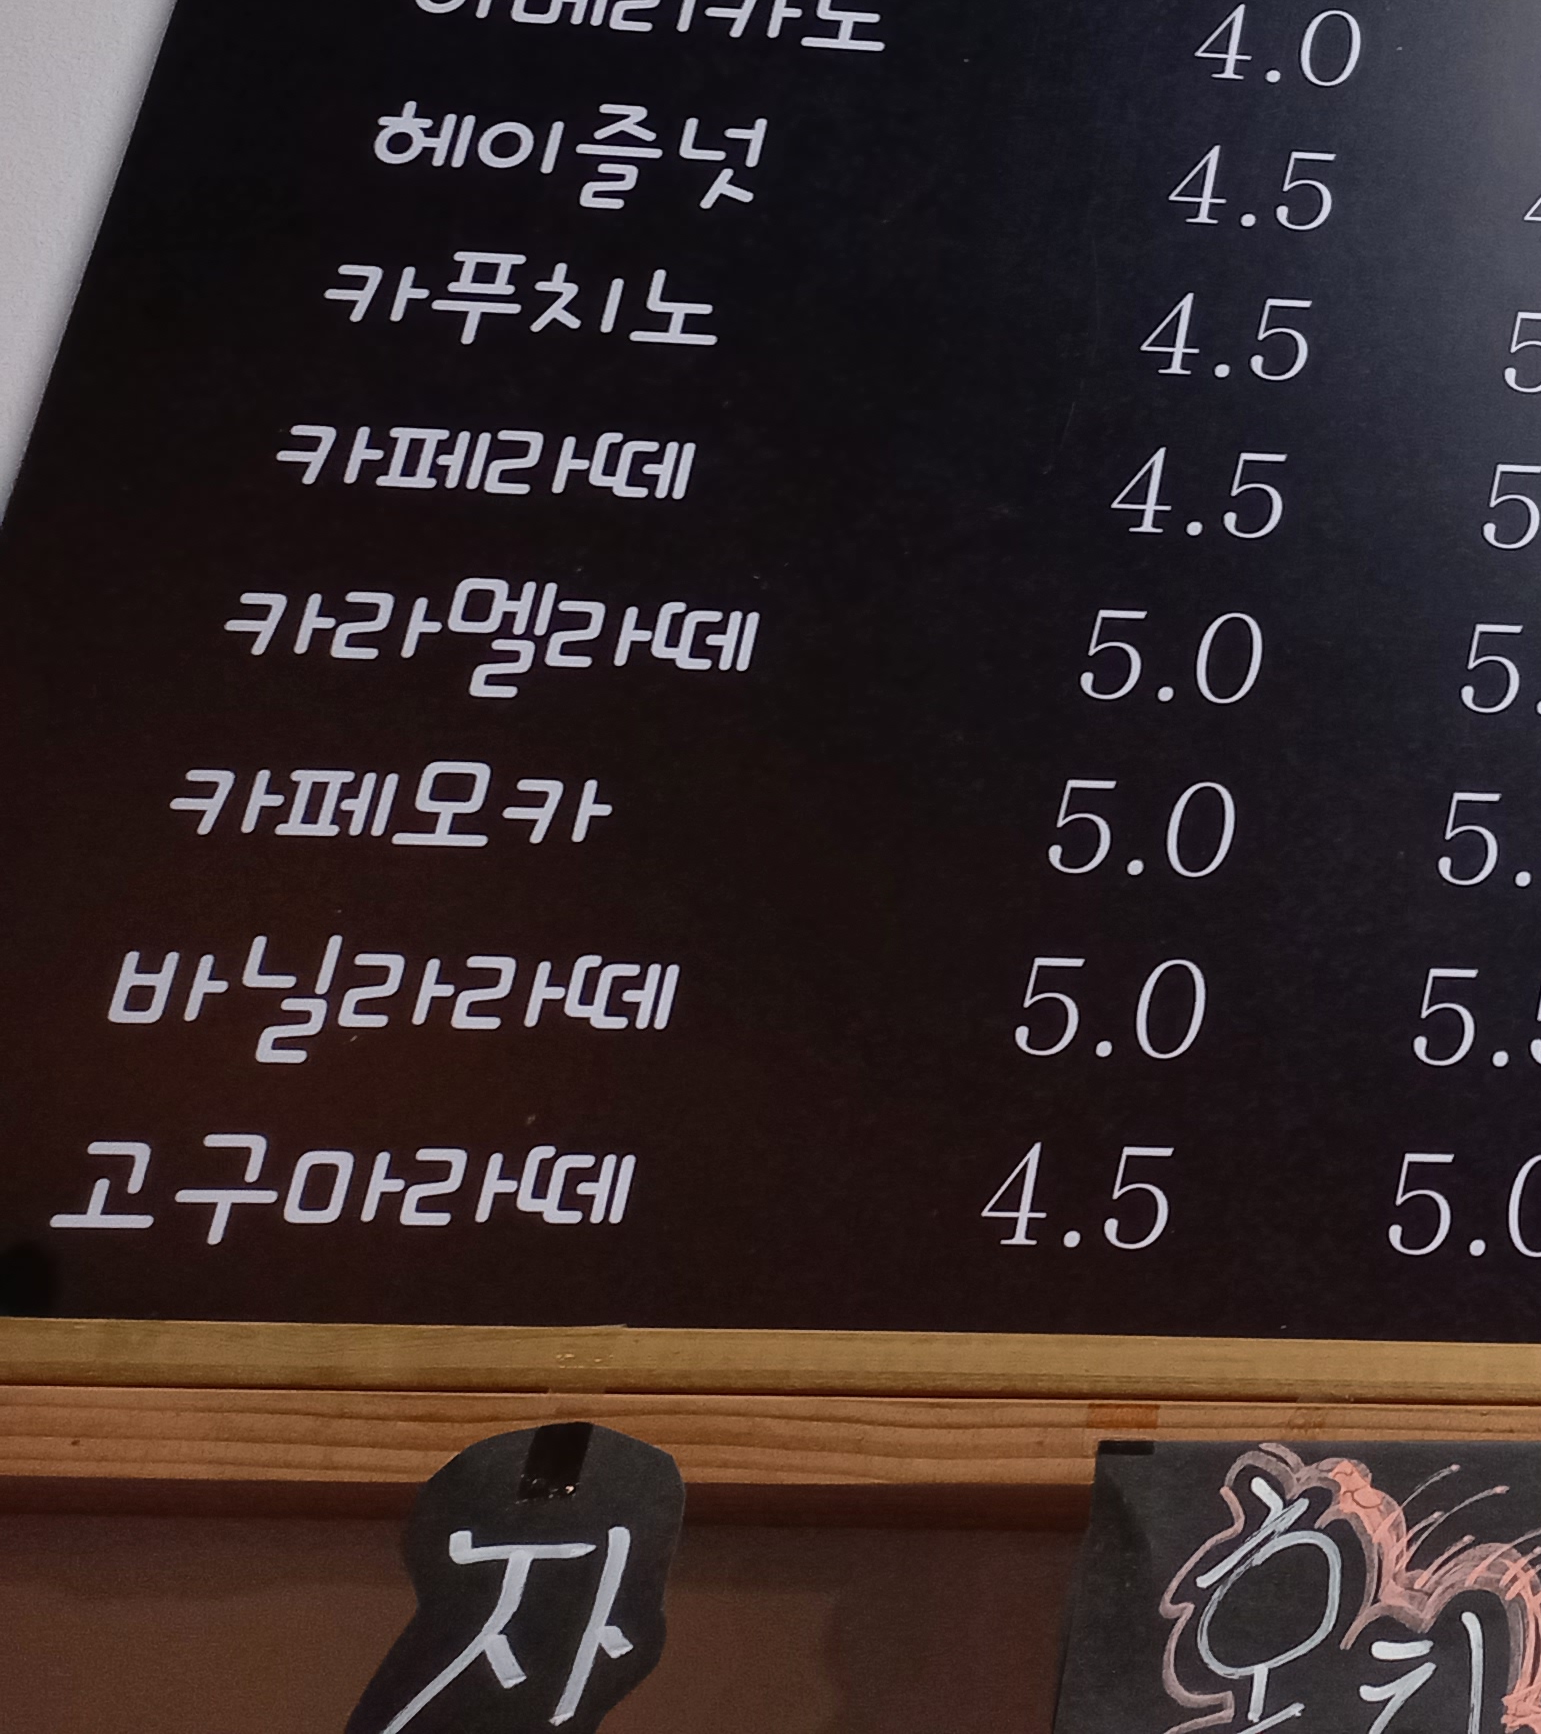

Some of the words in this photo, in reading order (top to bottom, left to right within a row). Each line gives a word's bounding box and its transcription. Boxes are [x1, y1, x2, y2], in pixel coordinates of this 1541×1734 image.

[1193, 2, 1363, 88] 4.0
[373, 99, 769, 211] 헤이즐넛
[1167, 144, 1338, 232] 4.5
[322, 250, 719, 347] 카푸치노
[1139, 291, 1314, 382] 4.5
[275, 423, 698, 501] 카페라떼
[1109, 445, 1289, 540] 4.5
[222, 576, 761, 699] 카라멜라떼
[1079, 608, 1264, 705] 5.0
[168, 760, 614, 848] 카페모카
[1047, 778, 1237, 879] 5.0
[106, 933, 681, 1065] 바닐라라떼
[1014, 956, 1207, 1060] 5.0
[48, 1132, 637, 1246] 고구마라떼
[979, 1140, 1176, 1251] 4.5
